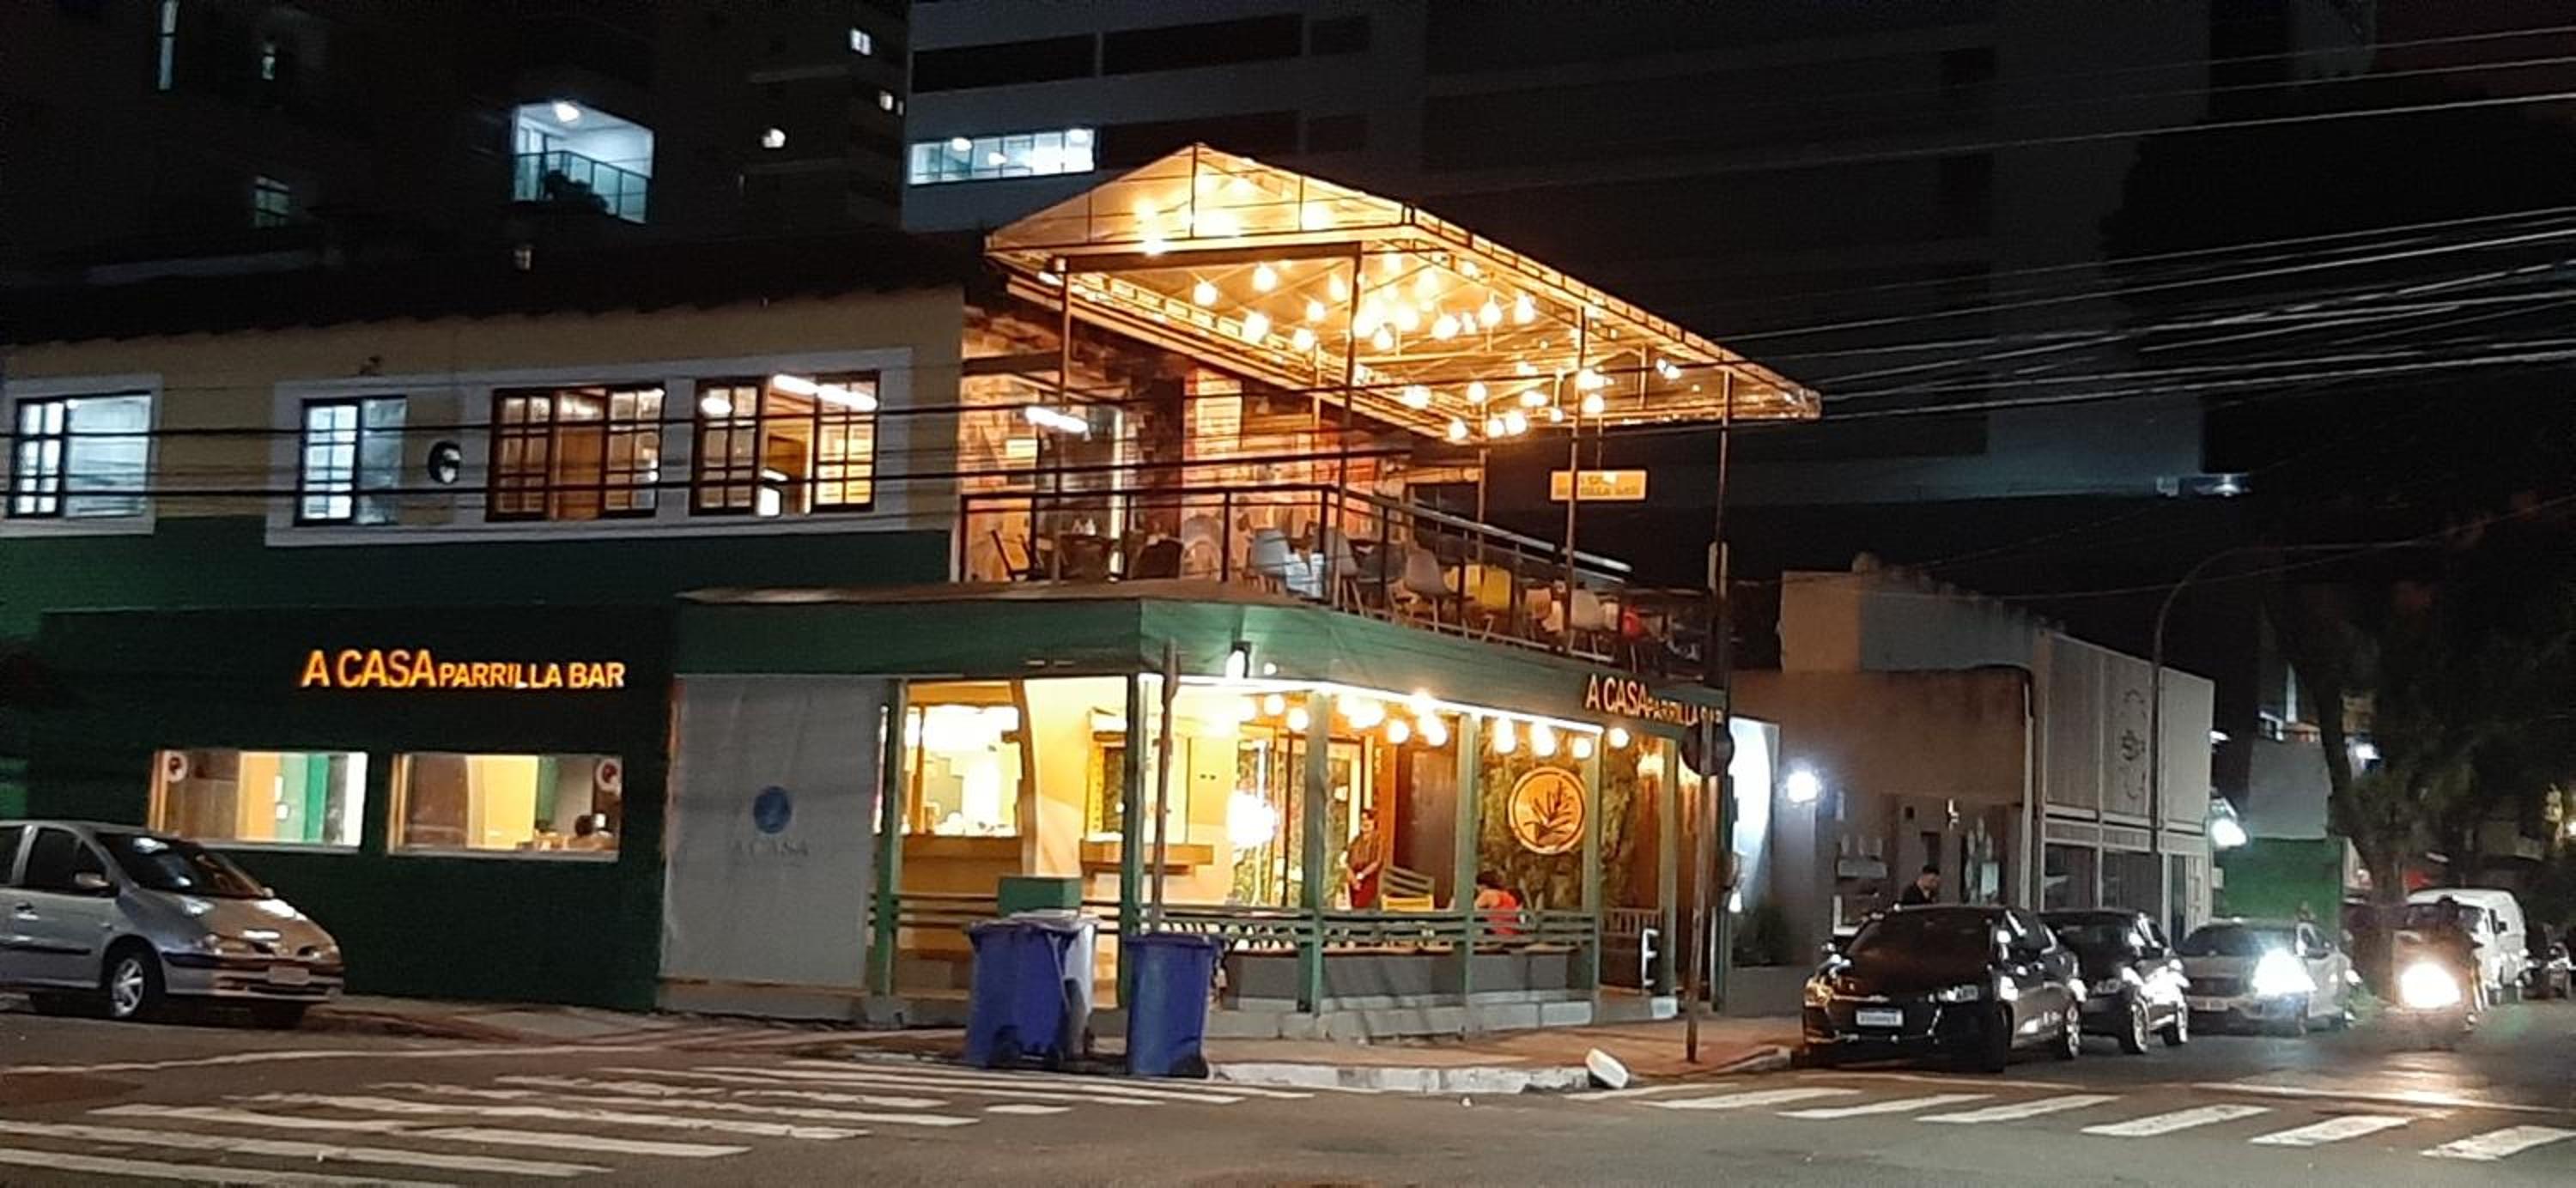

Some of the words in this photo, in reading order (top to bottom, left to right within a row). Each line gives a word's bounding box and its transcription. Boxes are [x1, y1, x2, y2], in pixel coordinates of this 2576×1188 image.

[302, 650, 331, 687] A
[337, 650, 436, 687] CASA
[439, 663, 563, 688] PARRILLA
[568, 663, 626, 688] BAR
[1585, 673, 1601, 710] A
[1603, 676, 1647, 718] CASA
